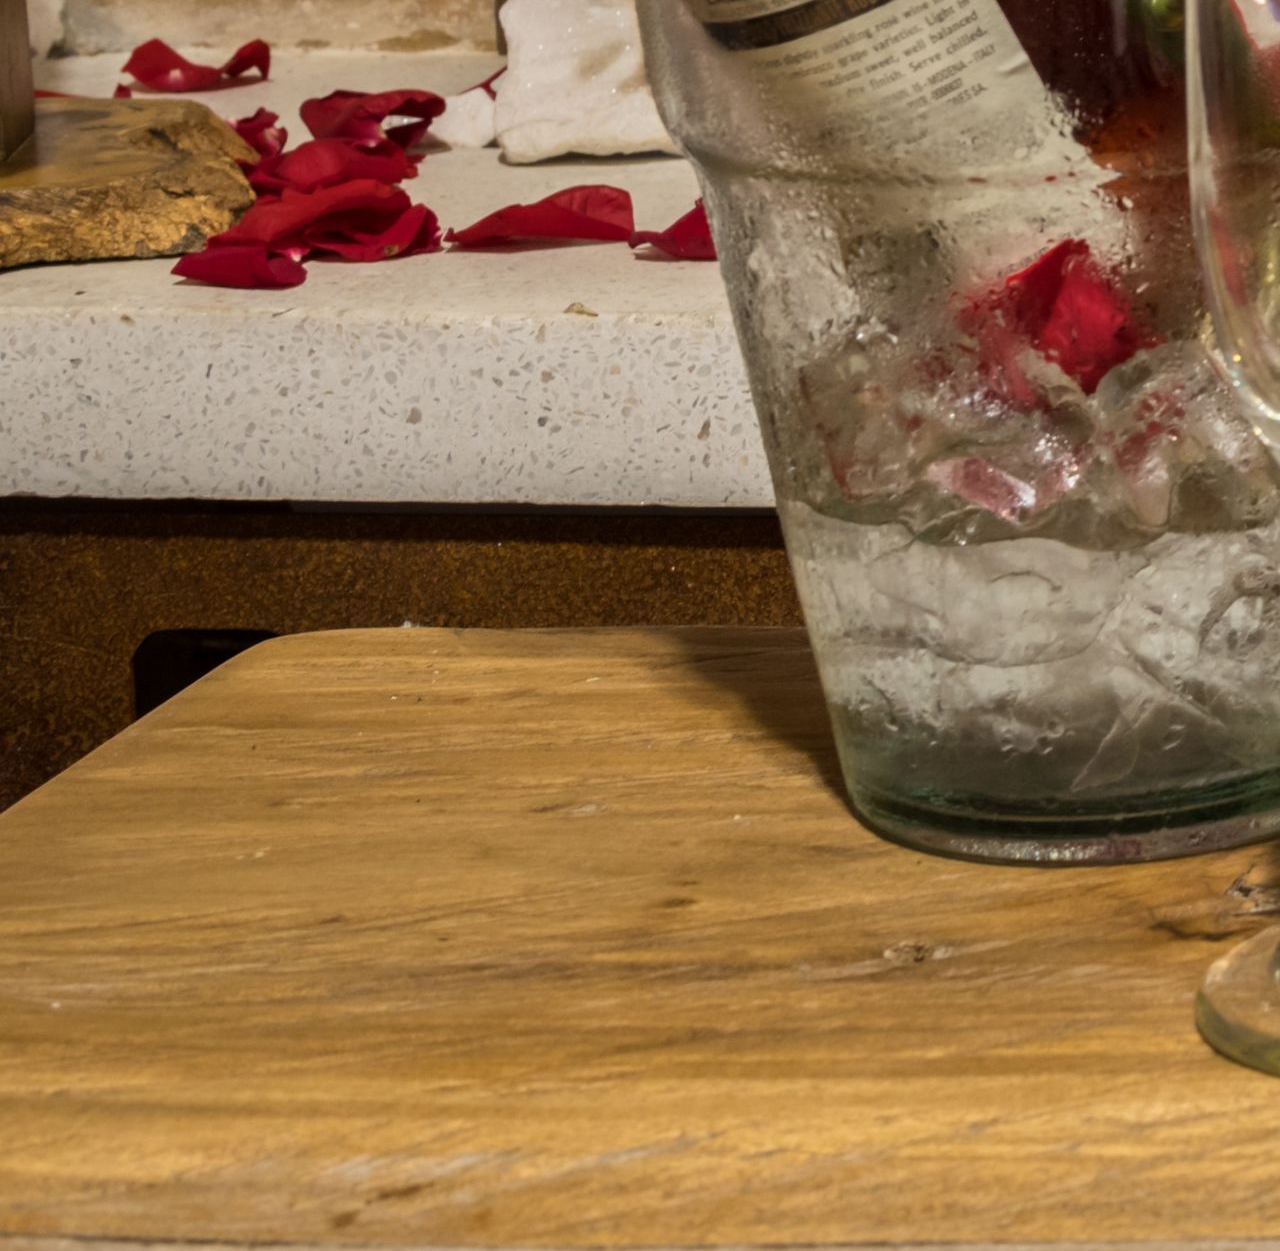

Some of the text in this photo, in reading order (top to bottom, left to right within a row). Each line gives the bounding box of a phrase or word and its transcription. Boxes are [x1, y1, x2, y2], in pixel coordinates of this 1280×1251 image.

[902, 37, 927, 58] well
[928, 9, 979, 45] balanced
[903, 0, 929, 20] wine
[837, 49, 868, 69] grape
[924, 5, 956, 28] Light
[908, 51, 942, 74] Serve
[945, 25, 989, 56] chilled.
[972, 43, 996, 63] ITALY
